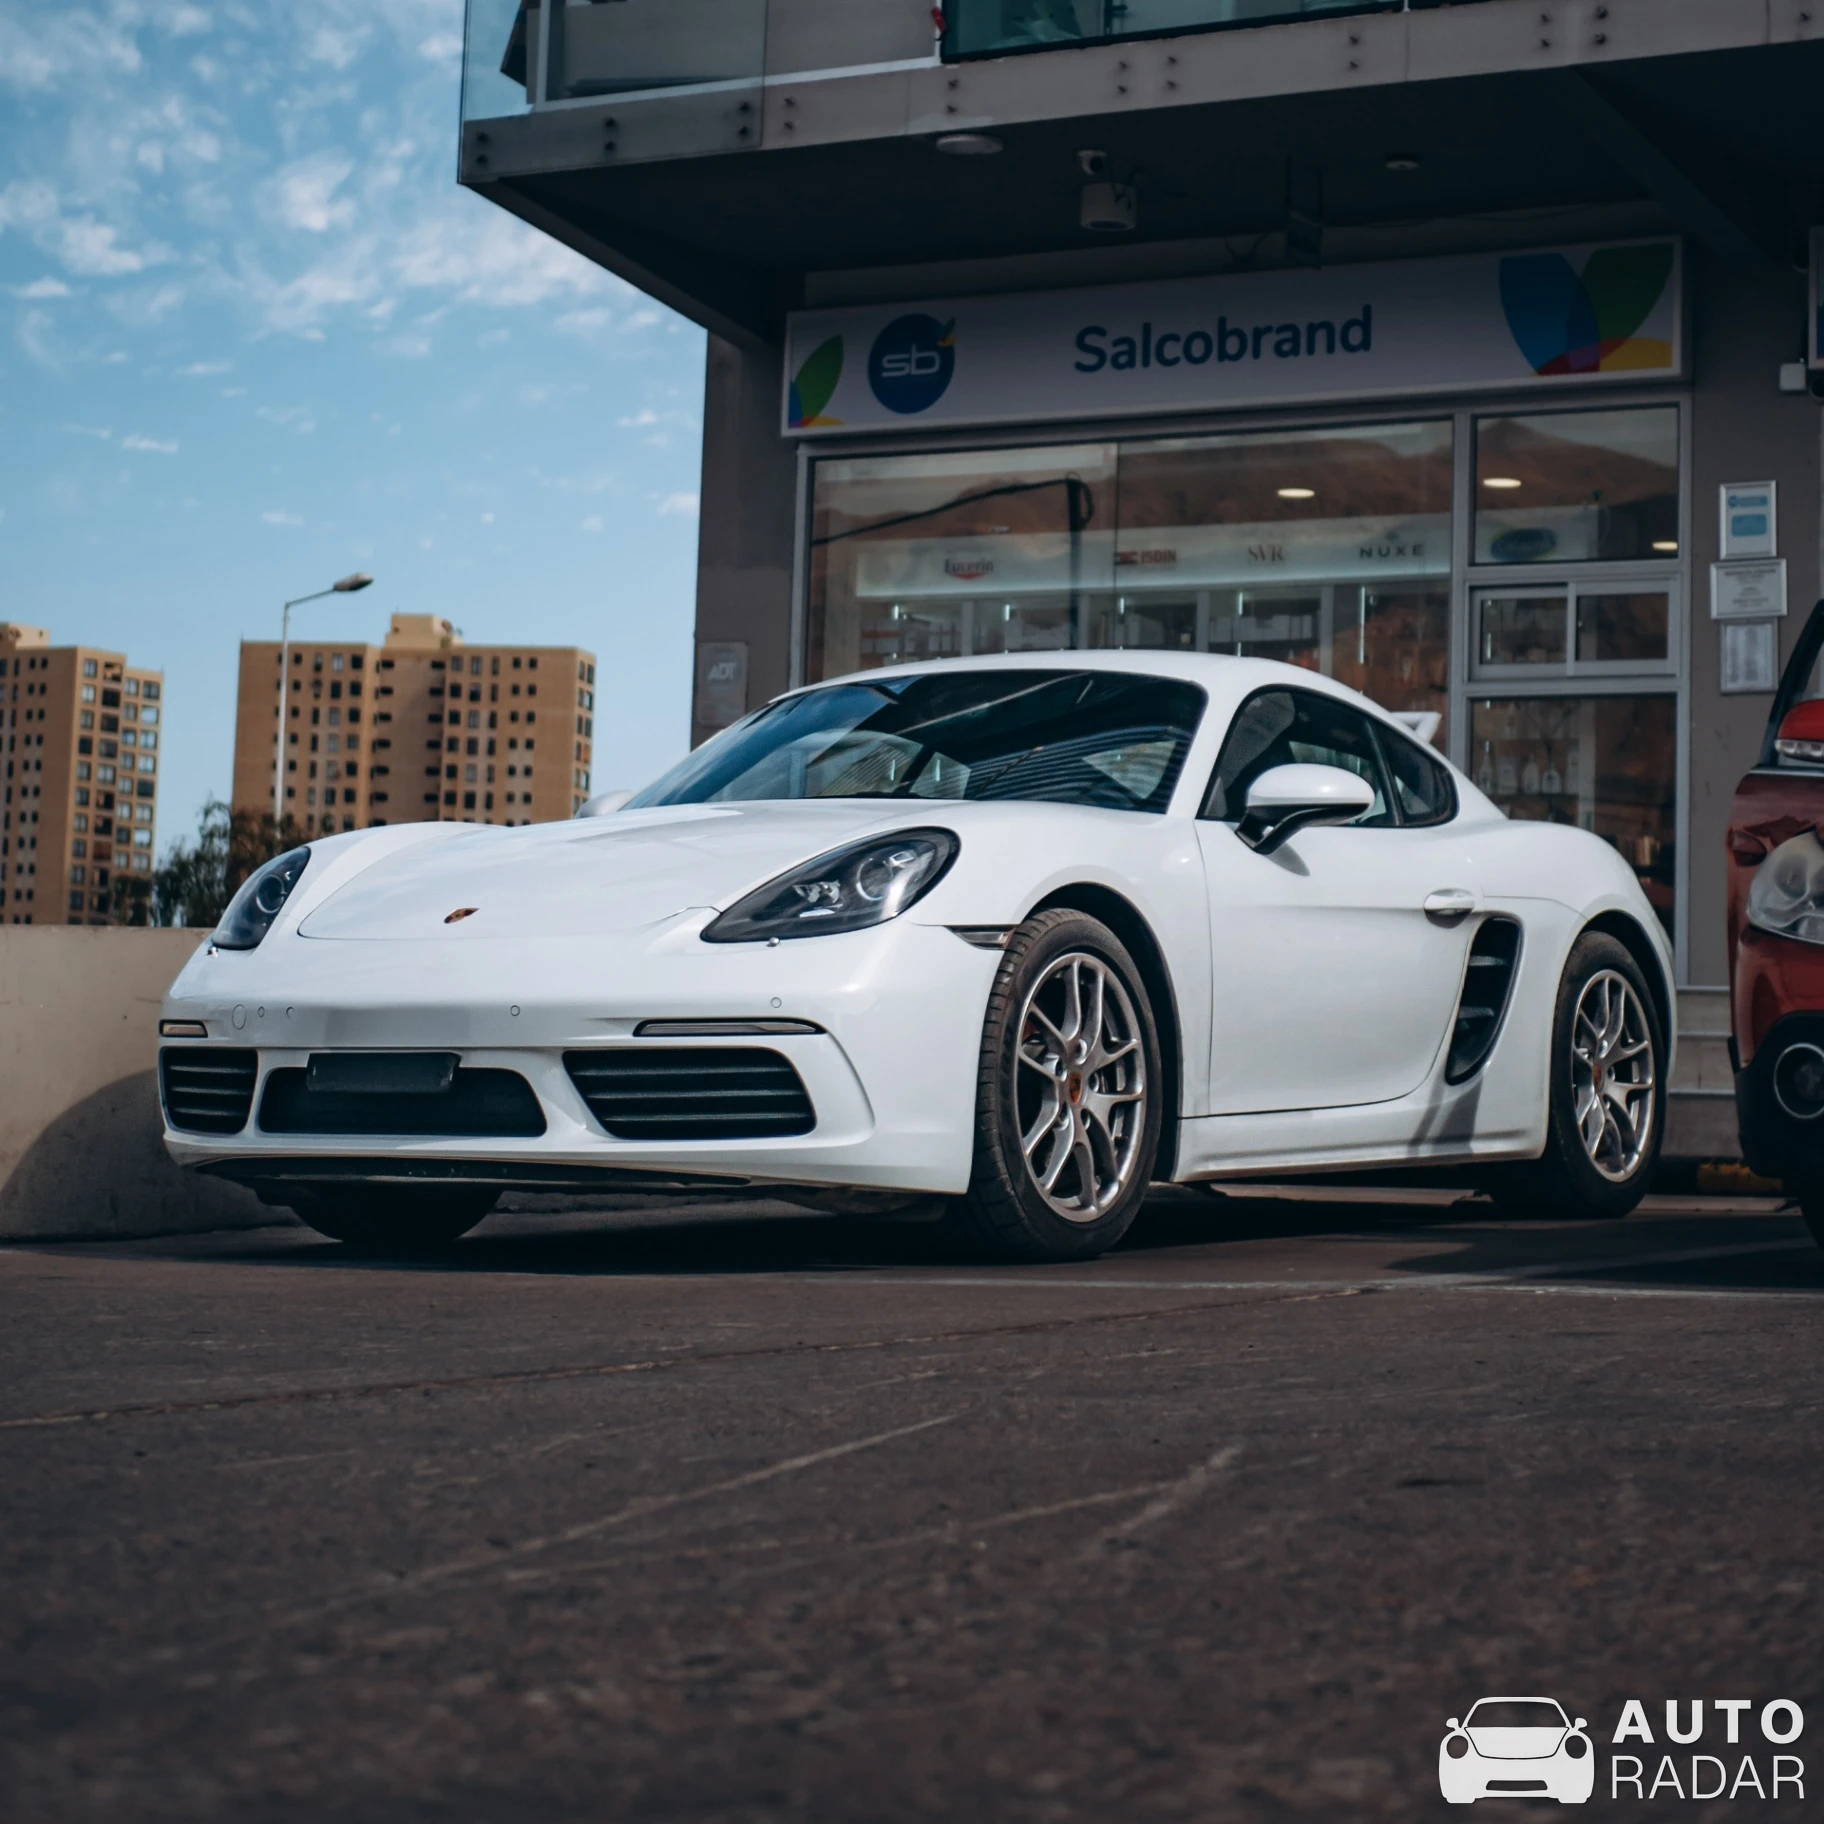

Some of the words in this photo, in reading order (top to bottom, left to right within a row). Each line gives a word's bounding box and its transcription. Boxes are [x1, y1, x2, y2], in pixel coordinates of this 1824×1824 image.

[1074, 303, 1373, 373] Salcobrand
[881, 344, 941, 378] sb
[1141, 549, 1177, 564] ISDIN
[1247, 544, 1285, 562] SVR
[1359, 543, 1424, 559] NUXE
[708, 662, 737, 680] ADT
